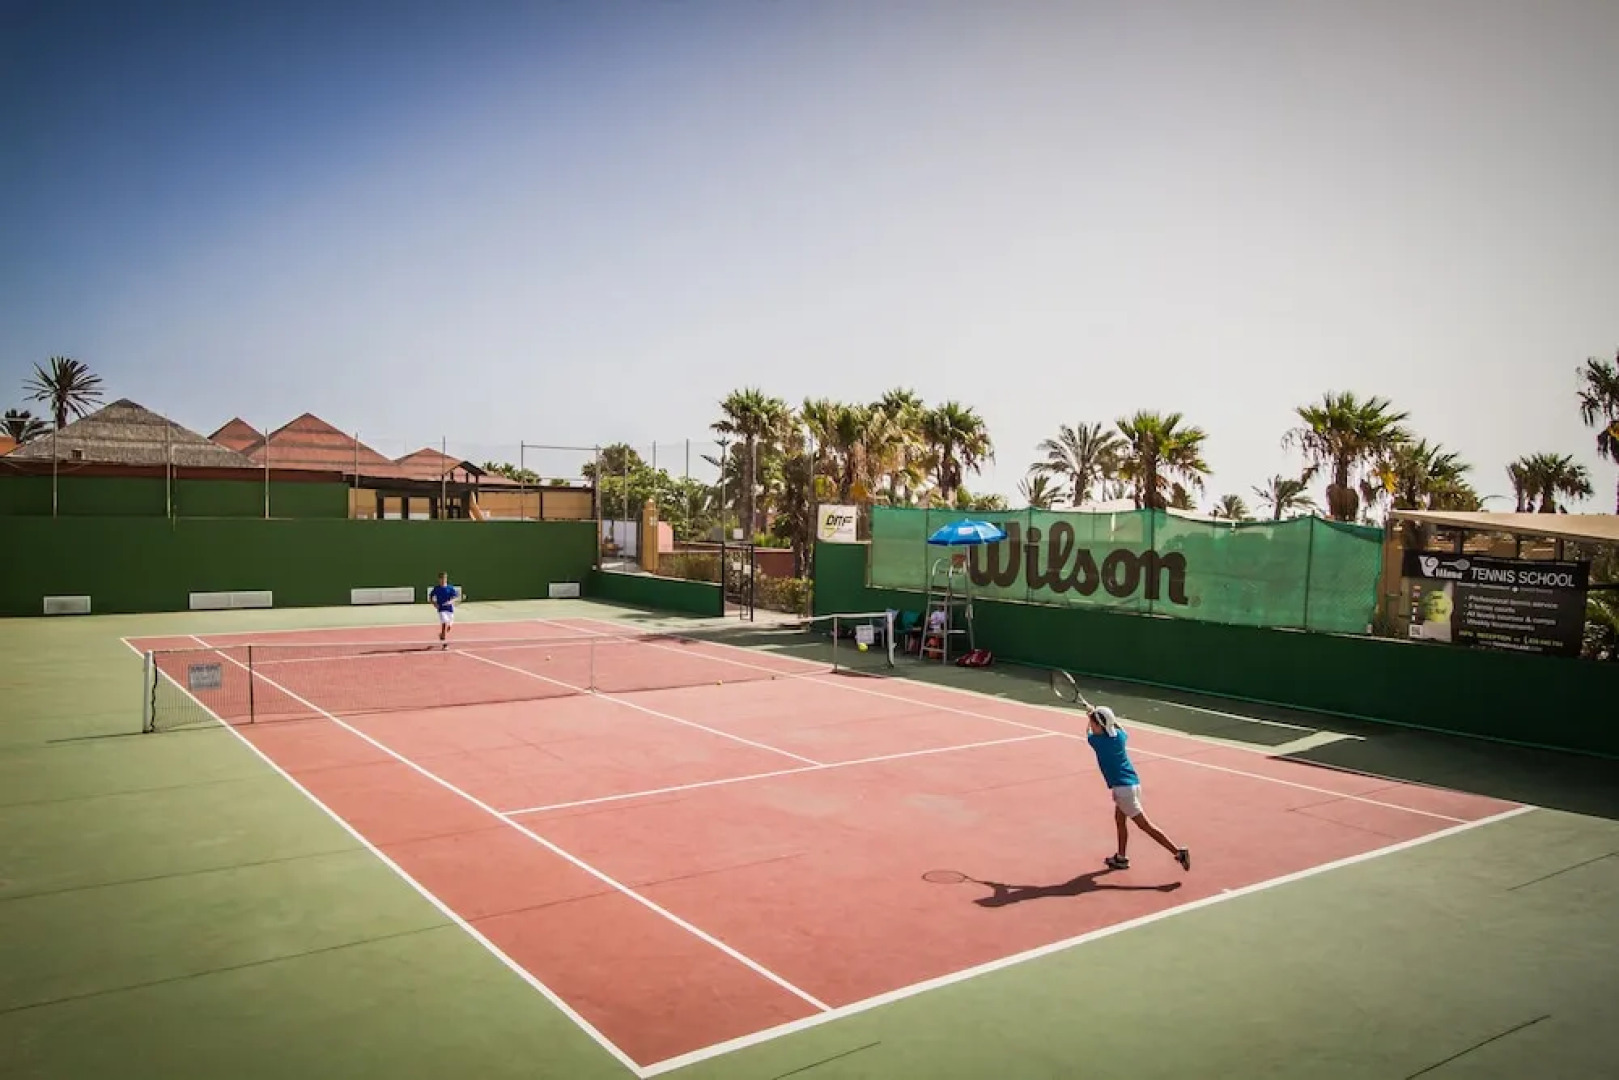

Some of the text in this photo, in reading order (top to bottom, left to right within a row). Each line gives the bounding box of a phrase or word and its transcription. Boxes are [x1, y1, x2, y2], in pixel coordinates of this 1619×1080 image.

[968, 520, 1188, 605] Wilson
[1470, 566, 1515, 584] TENNIS
[1519, 570, 1575, 587] SCHOOL
